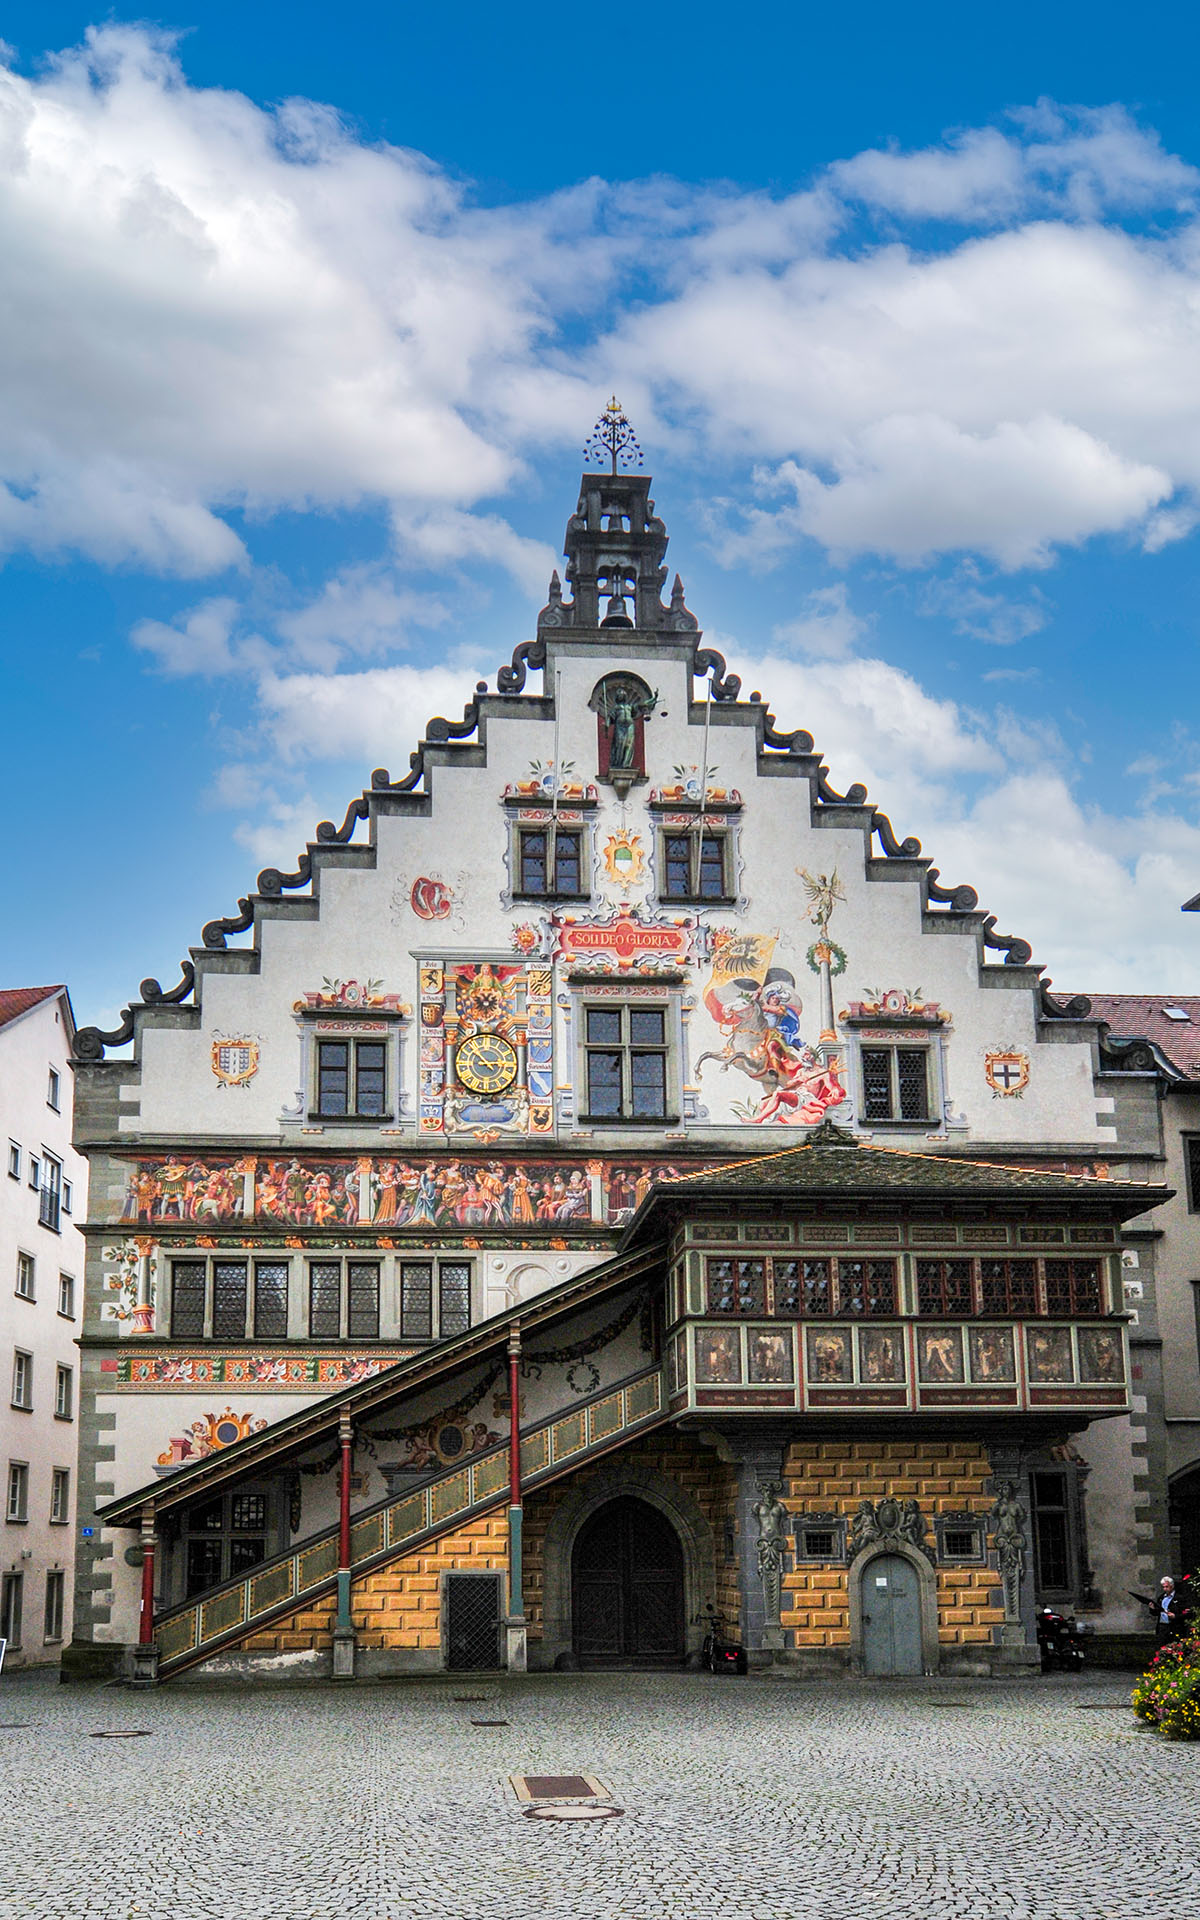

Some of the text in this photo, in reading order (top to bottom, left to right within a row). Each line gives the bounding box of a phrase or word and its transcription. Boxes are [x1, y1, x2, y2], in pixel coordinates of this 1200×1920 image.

[575, 932, 672, 946] SOLI DEO GLORIA
